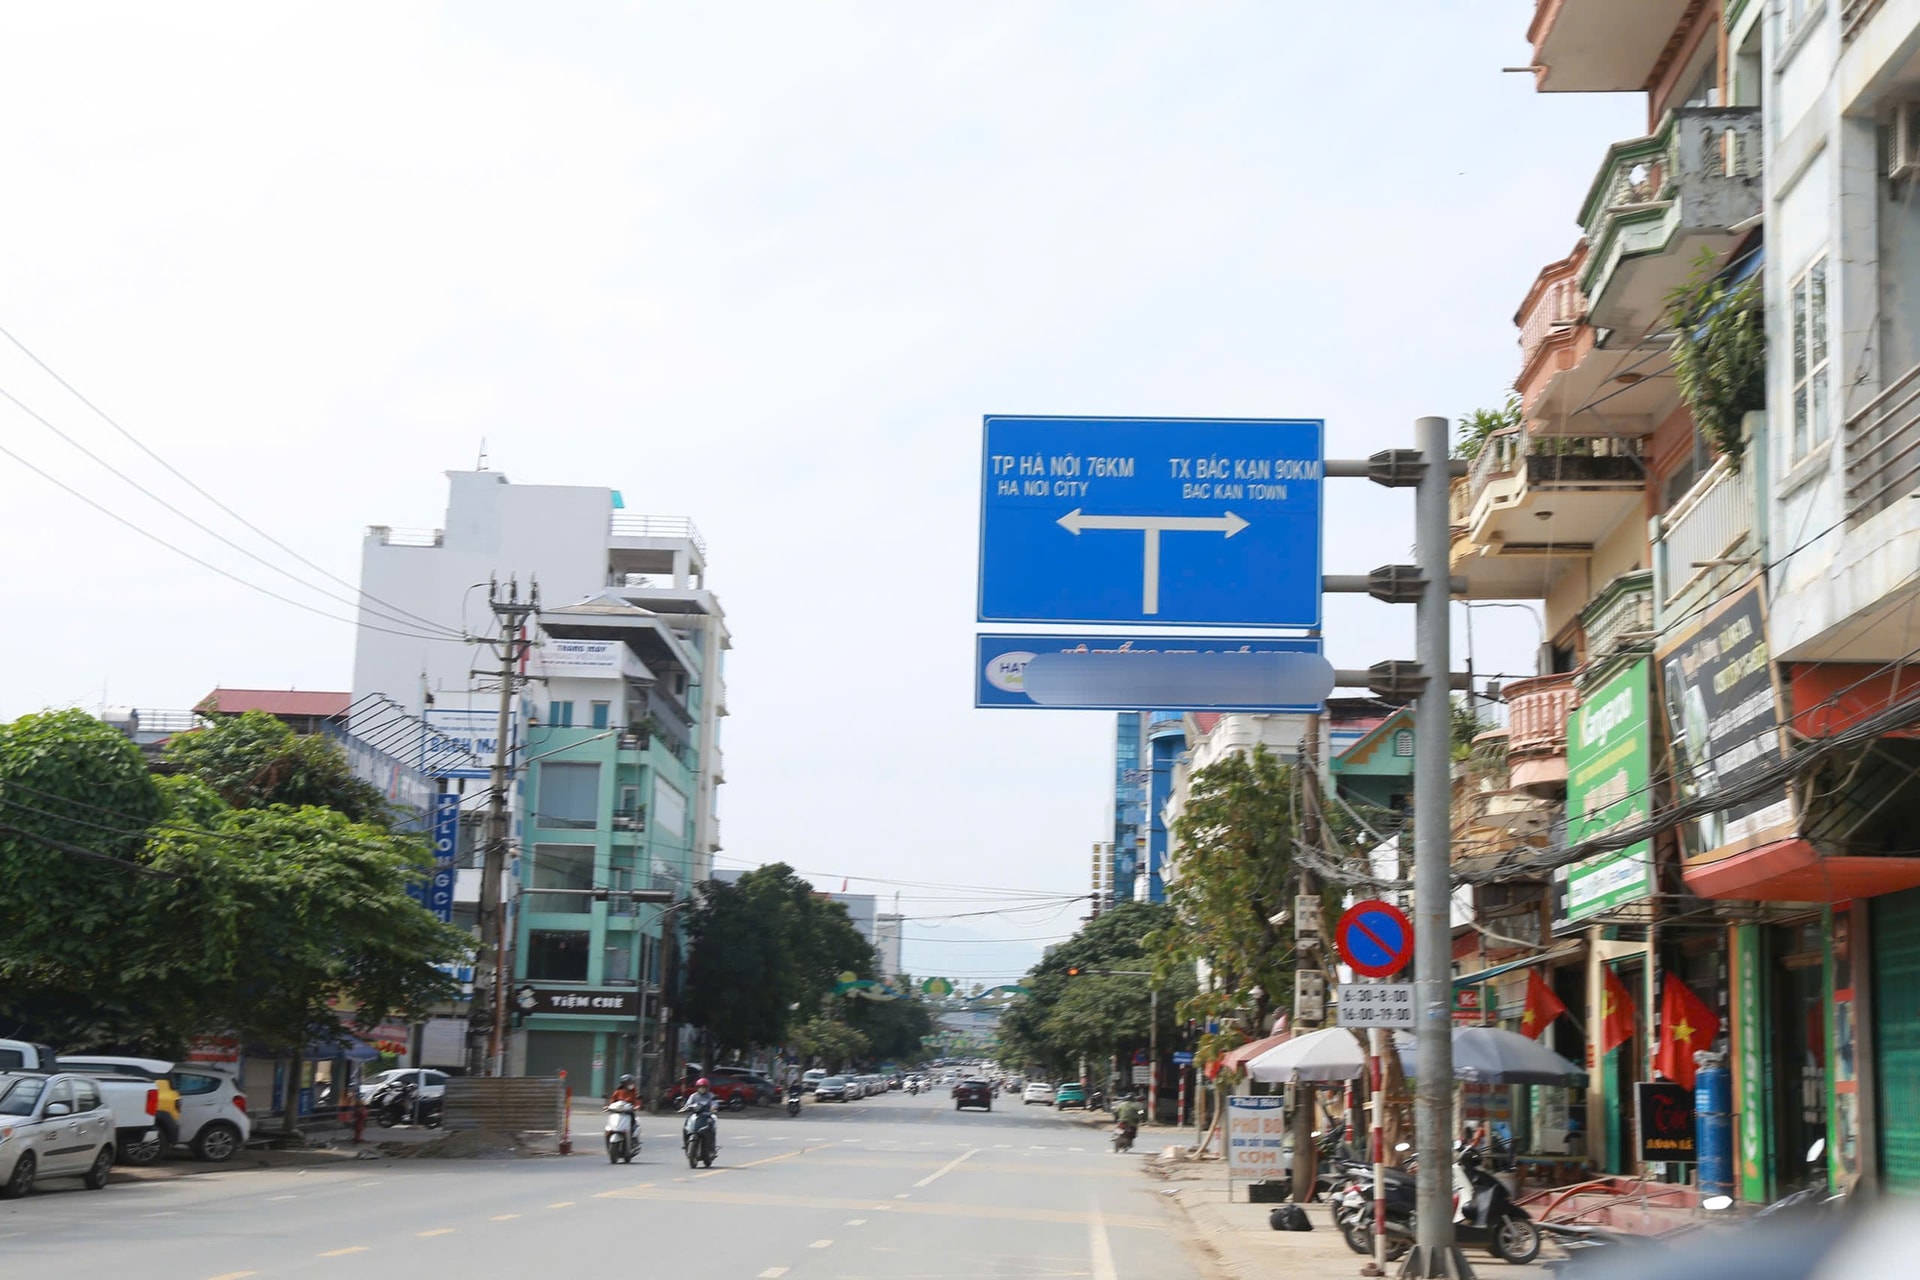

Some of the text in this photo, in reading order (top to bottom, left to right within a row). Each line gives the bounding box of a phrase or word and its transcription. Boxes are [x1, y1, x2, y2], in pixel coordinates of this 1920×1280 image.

[992, 452, 1135, 480] TP HÀ NỘI 76KM
[1169, 458, 1192, 479] TX
[1196, 452, 1231, 479] BẮC
[1275, 459, 1320, 480] 90KM
[997, 480, 1090, 497] HA NOI CITY
[1182, 482, 1288, 500] BAC KAN TOWN
